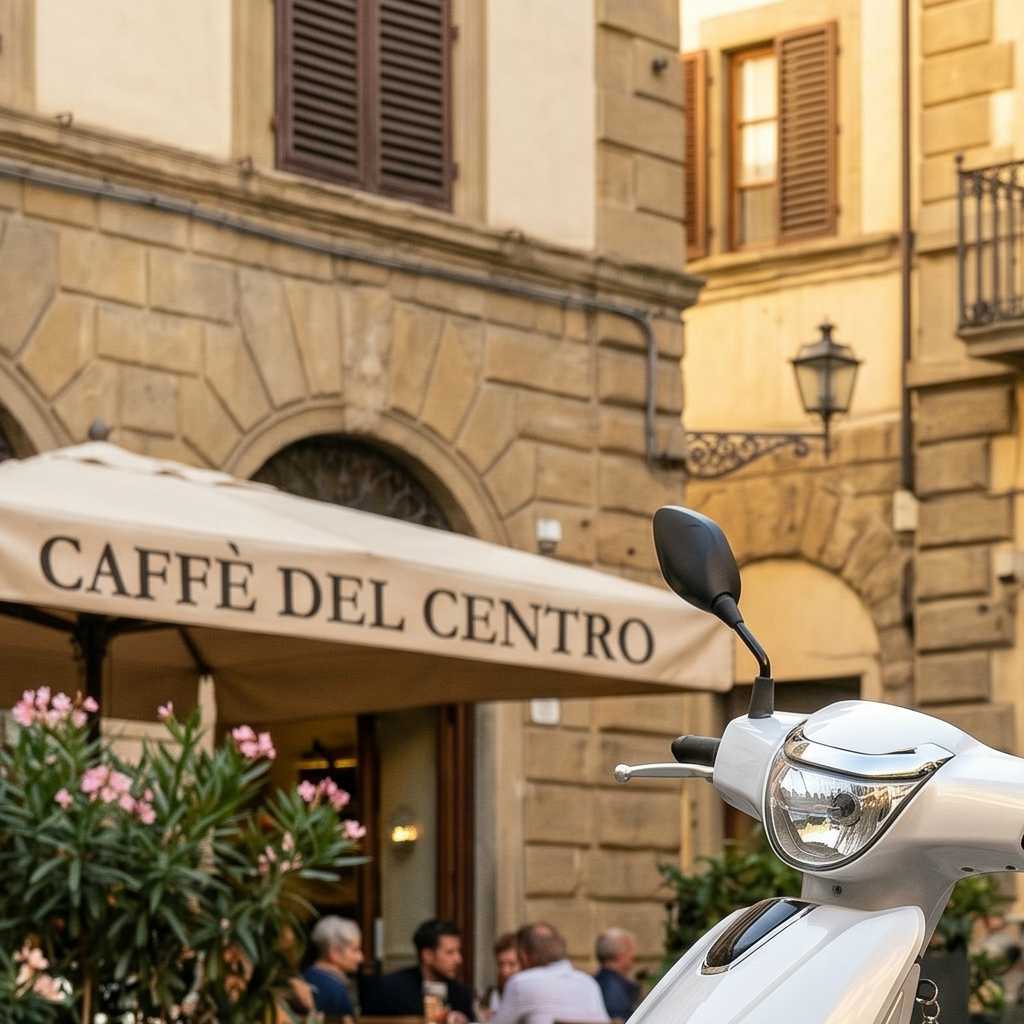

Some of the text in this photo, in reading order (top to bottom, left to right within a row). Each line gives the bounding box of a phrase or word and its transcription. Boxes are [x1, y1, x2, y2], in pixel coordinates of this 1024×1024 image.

[39, 535, 655, 665] CAFFÈ DEL CENTRO
